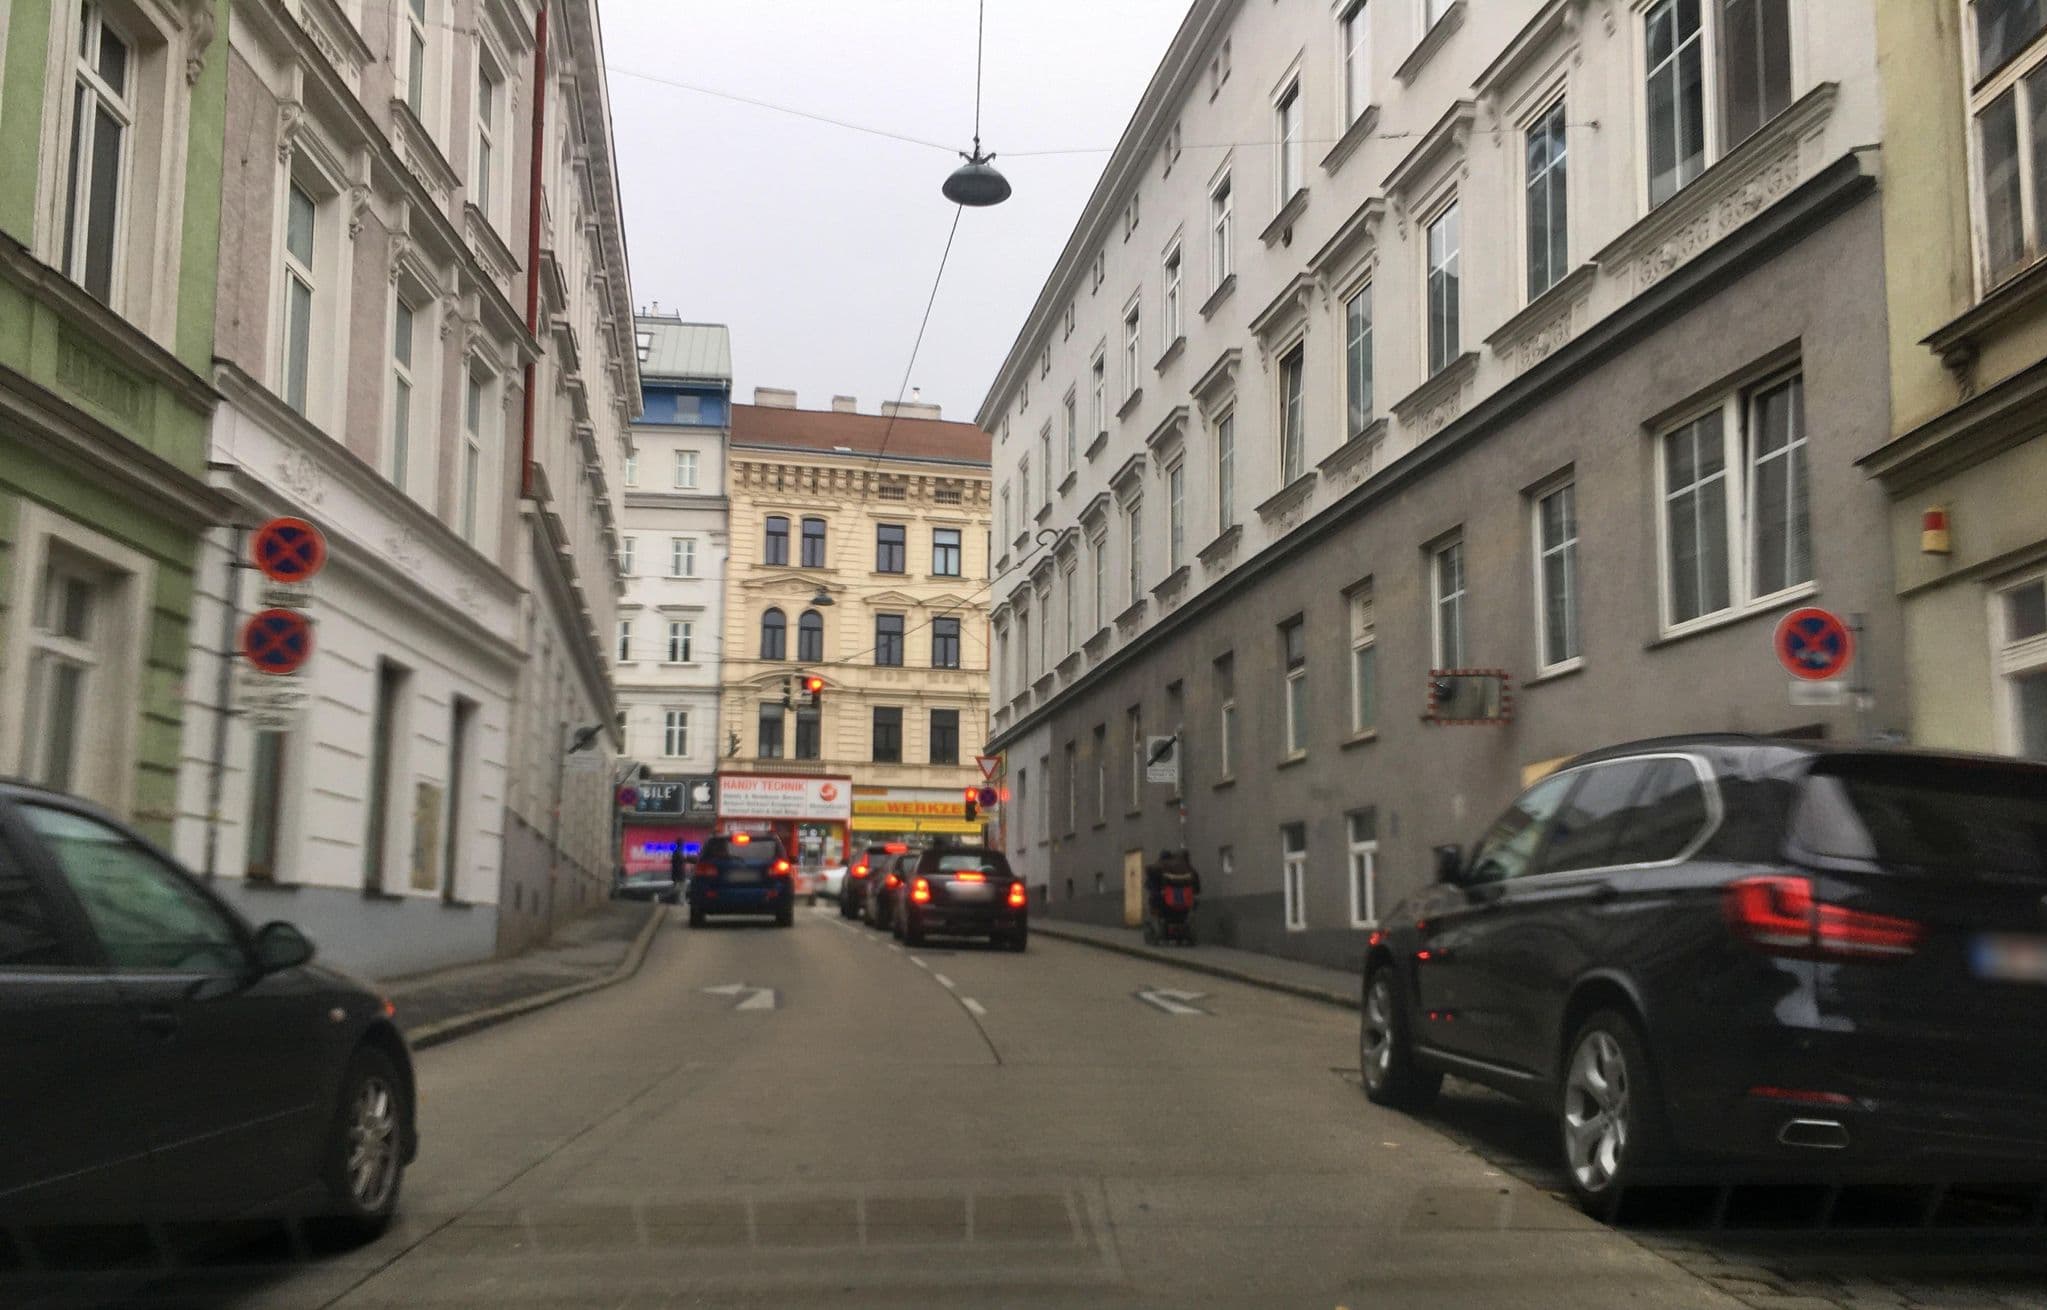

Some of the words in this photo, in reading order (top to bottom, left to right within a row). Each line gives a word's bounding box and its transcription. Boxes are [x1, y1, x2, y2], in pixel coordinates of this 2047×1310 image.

[642, 785, 672, 799] BILE
[723, 779, 758, 791] HANDY
[763, 780, 805, 792] TECHNIK
[886, 801, 963, 814] WERKZE
